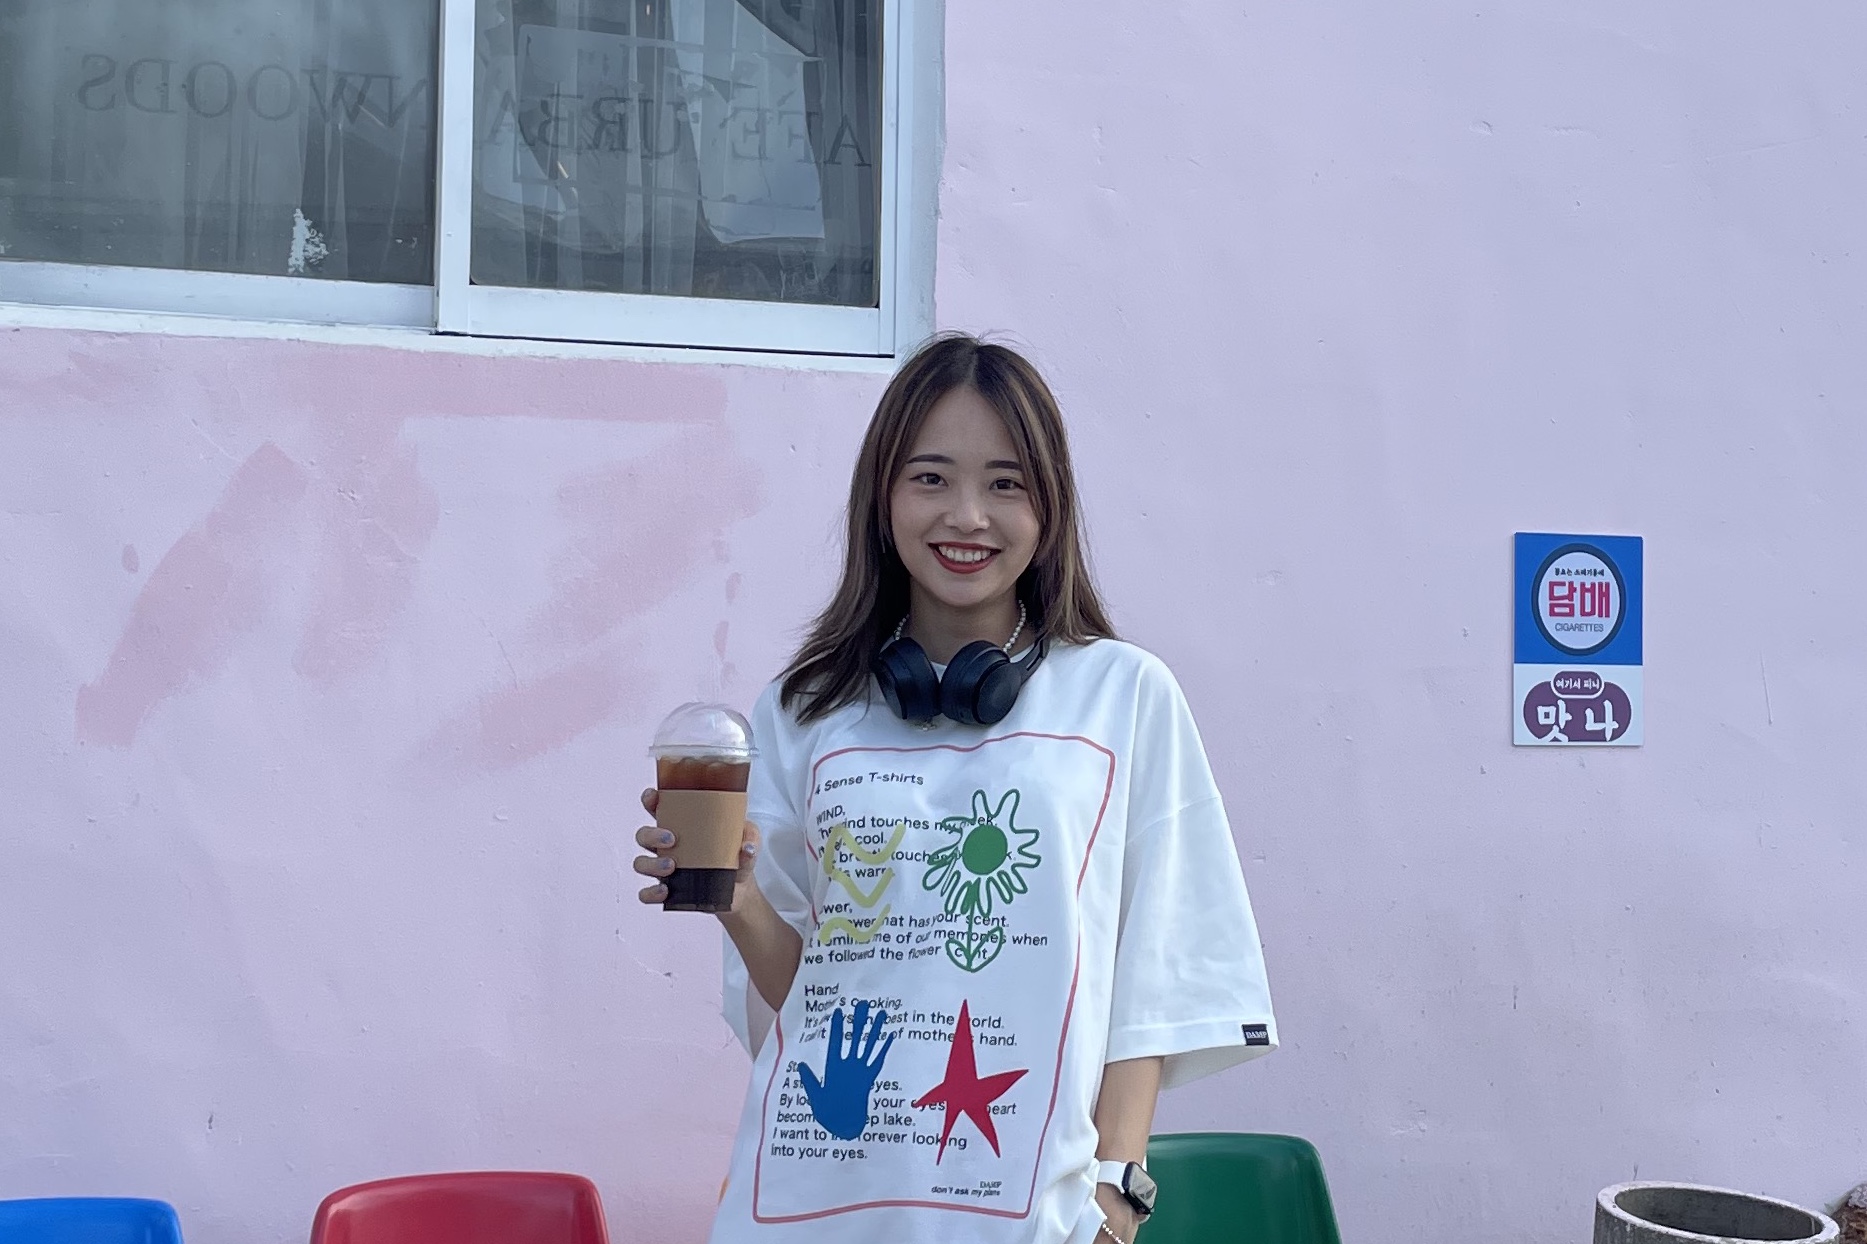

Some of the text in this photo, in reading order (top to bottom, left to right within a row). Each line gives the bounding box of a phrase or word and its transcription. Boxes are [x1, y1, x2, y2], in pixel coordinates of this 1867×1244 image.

[1549, 581, 1610, 617] 담배
[1554, 622, 1604, 632] CIGARETTES
[1555, 677, 1580, 690] 여기서
[824, 775, 863, 792] Sense
[868, 771, 924, 786] T-shirts
[842, 815, 866, 829] ind
[908, 914, 930, 928] has
[896, 931, 912, 944] of
[1012, 933, 1048, 946] when
[804, 953, 823, 965] we
[880, 947, 904, 961] the
[851, 997, 903, 1010] coking.
[912, 1009, 925, 1023] in
[930, 1011, 955, 1025] the
[969, 1015, 1005, 1029] orld.
[979, 1032, 1018, 1046] hand.
[780, 1093, 793, 1108] By
[873, 1096, 906, 1110] your
[883, 1112, 916, 1126] lake.
[780, 1128, 810, 1140] want
[814, 1130, 827, 1141] to
[858, 1131, 907, 1144] orever
[912, 1131, 967, 1150] lookng
[798, 1146, 829, 1160] your
[832, 1148, 868, 1161] eyes.
[954, 1187, 969, 1196] ask
